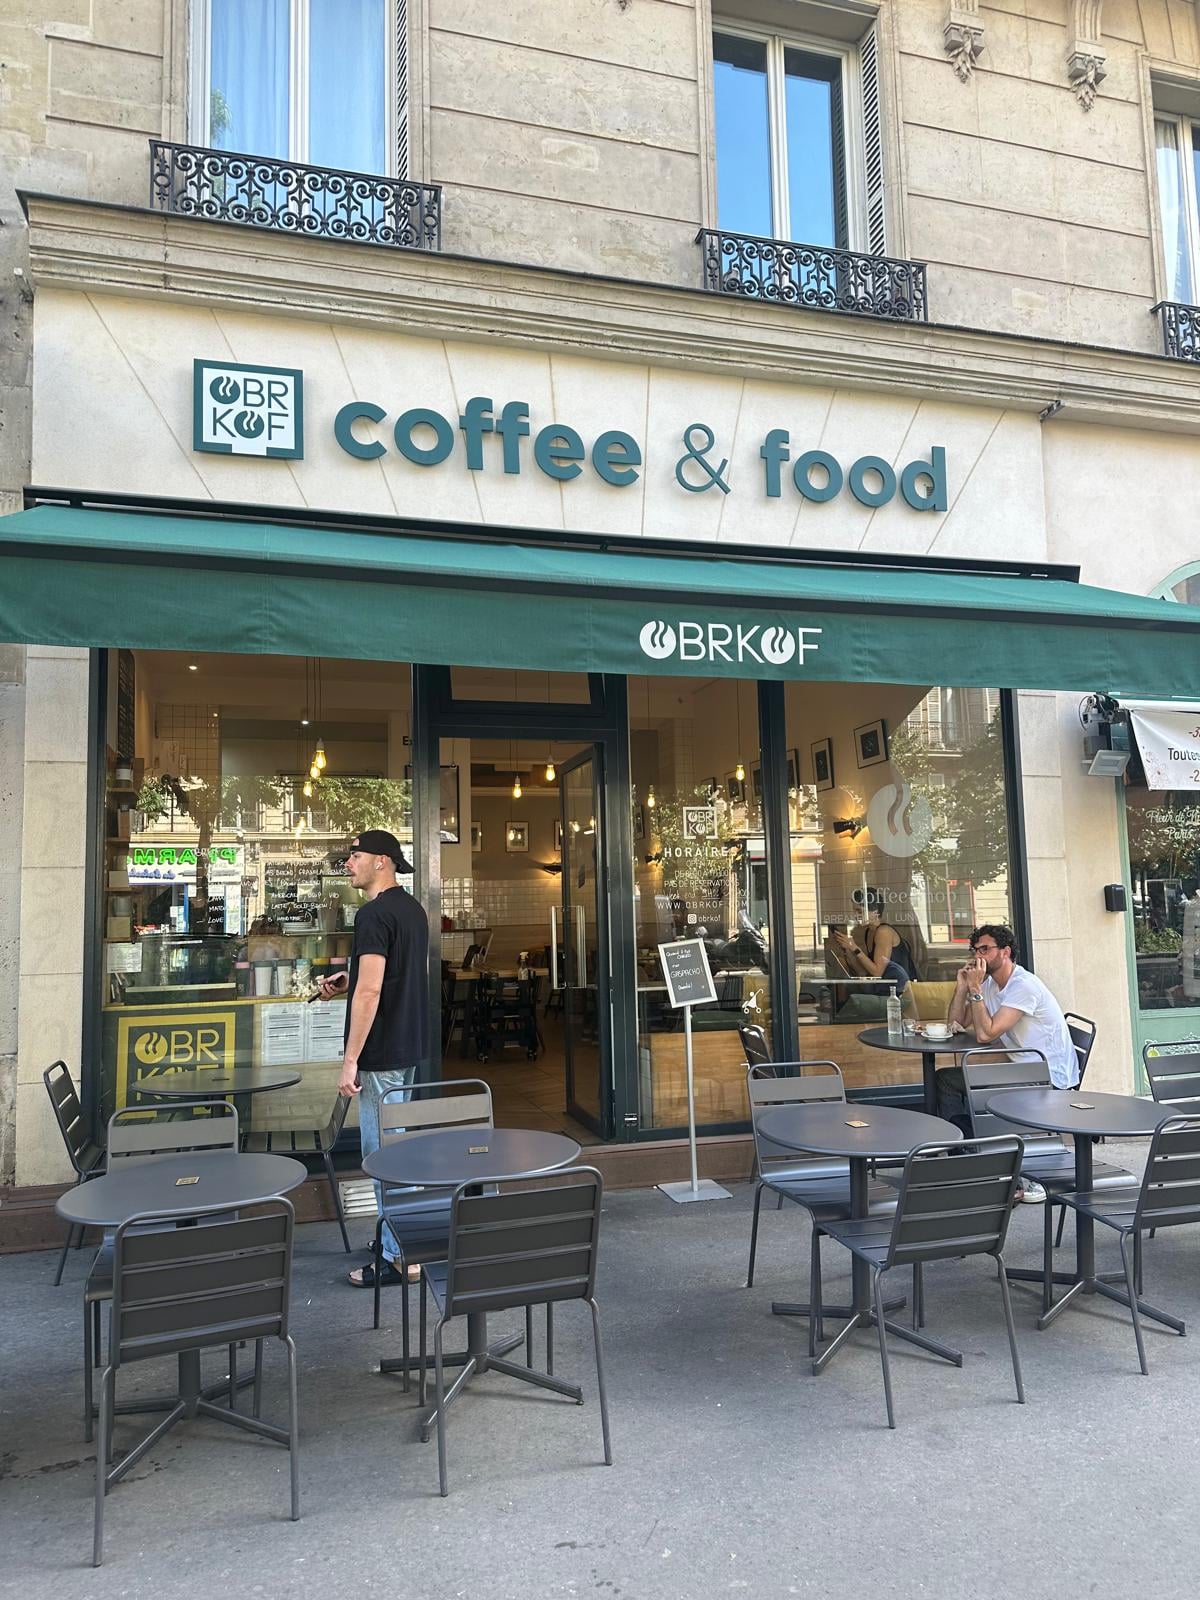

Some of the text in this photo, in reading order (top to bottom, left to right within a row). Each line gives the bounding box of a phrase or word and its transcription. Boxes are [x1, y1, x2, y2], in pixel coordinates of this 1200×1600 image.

[334, 396, 948, 512] coffee & food
[852, 888, 907, 904] Coffee
